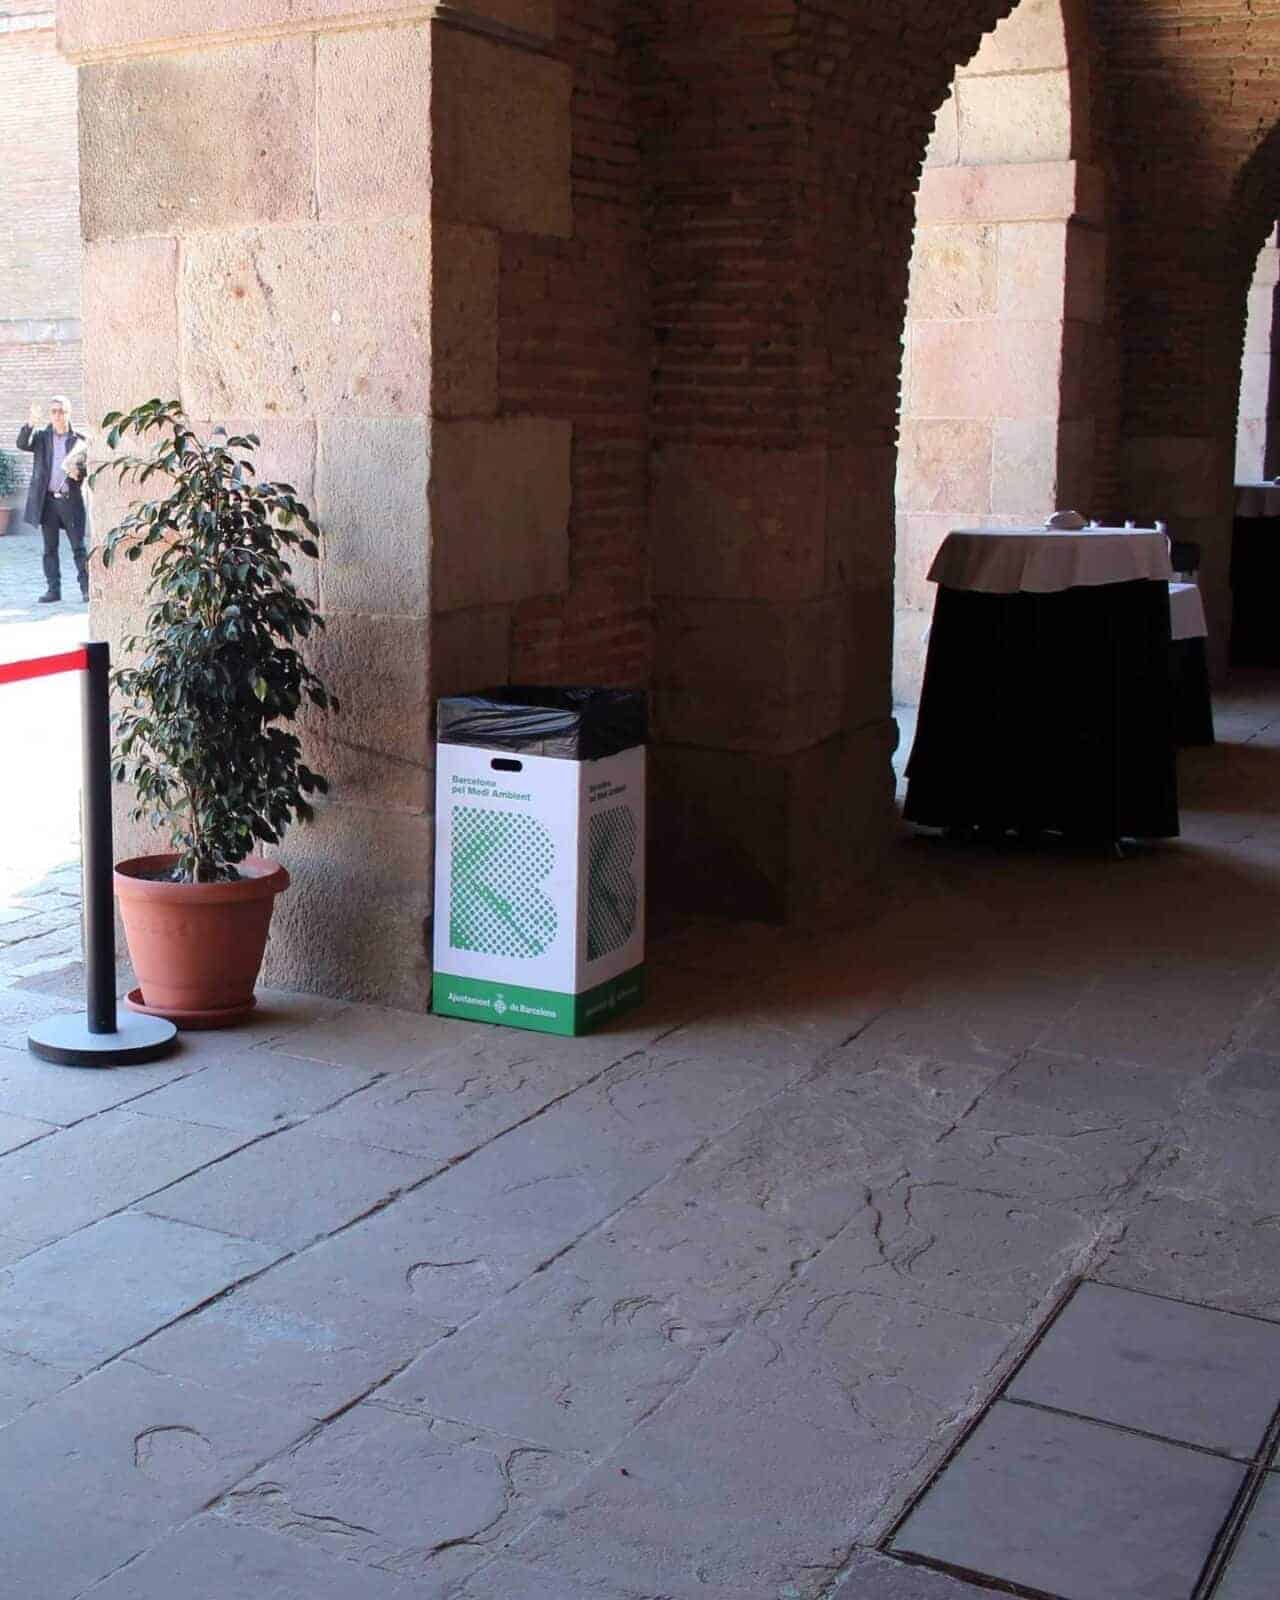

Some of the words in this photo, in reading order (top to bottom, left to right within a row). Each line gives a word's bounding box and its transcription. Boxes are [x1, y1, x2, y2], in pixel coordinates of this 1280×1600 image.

[451, 774, 497, 788] Barcelona
[467, 787, 490, 797] Medi
[492, 789, 532, 801] Ambient
[447, 991, 491, 1008] Ajuntament
[520, 1004, 558, 1019] Barcelona
